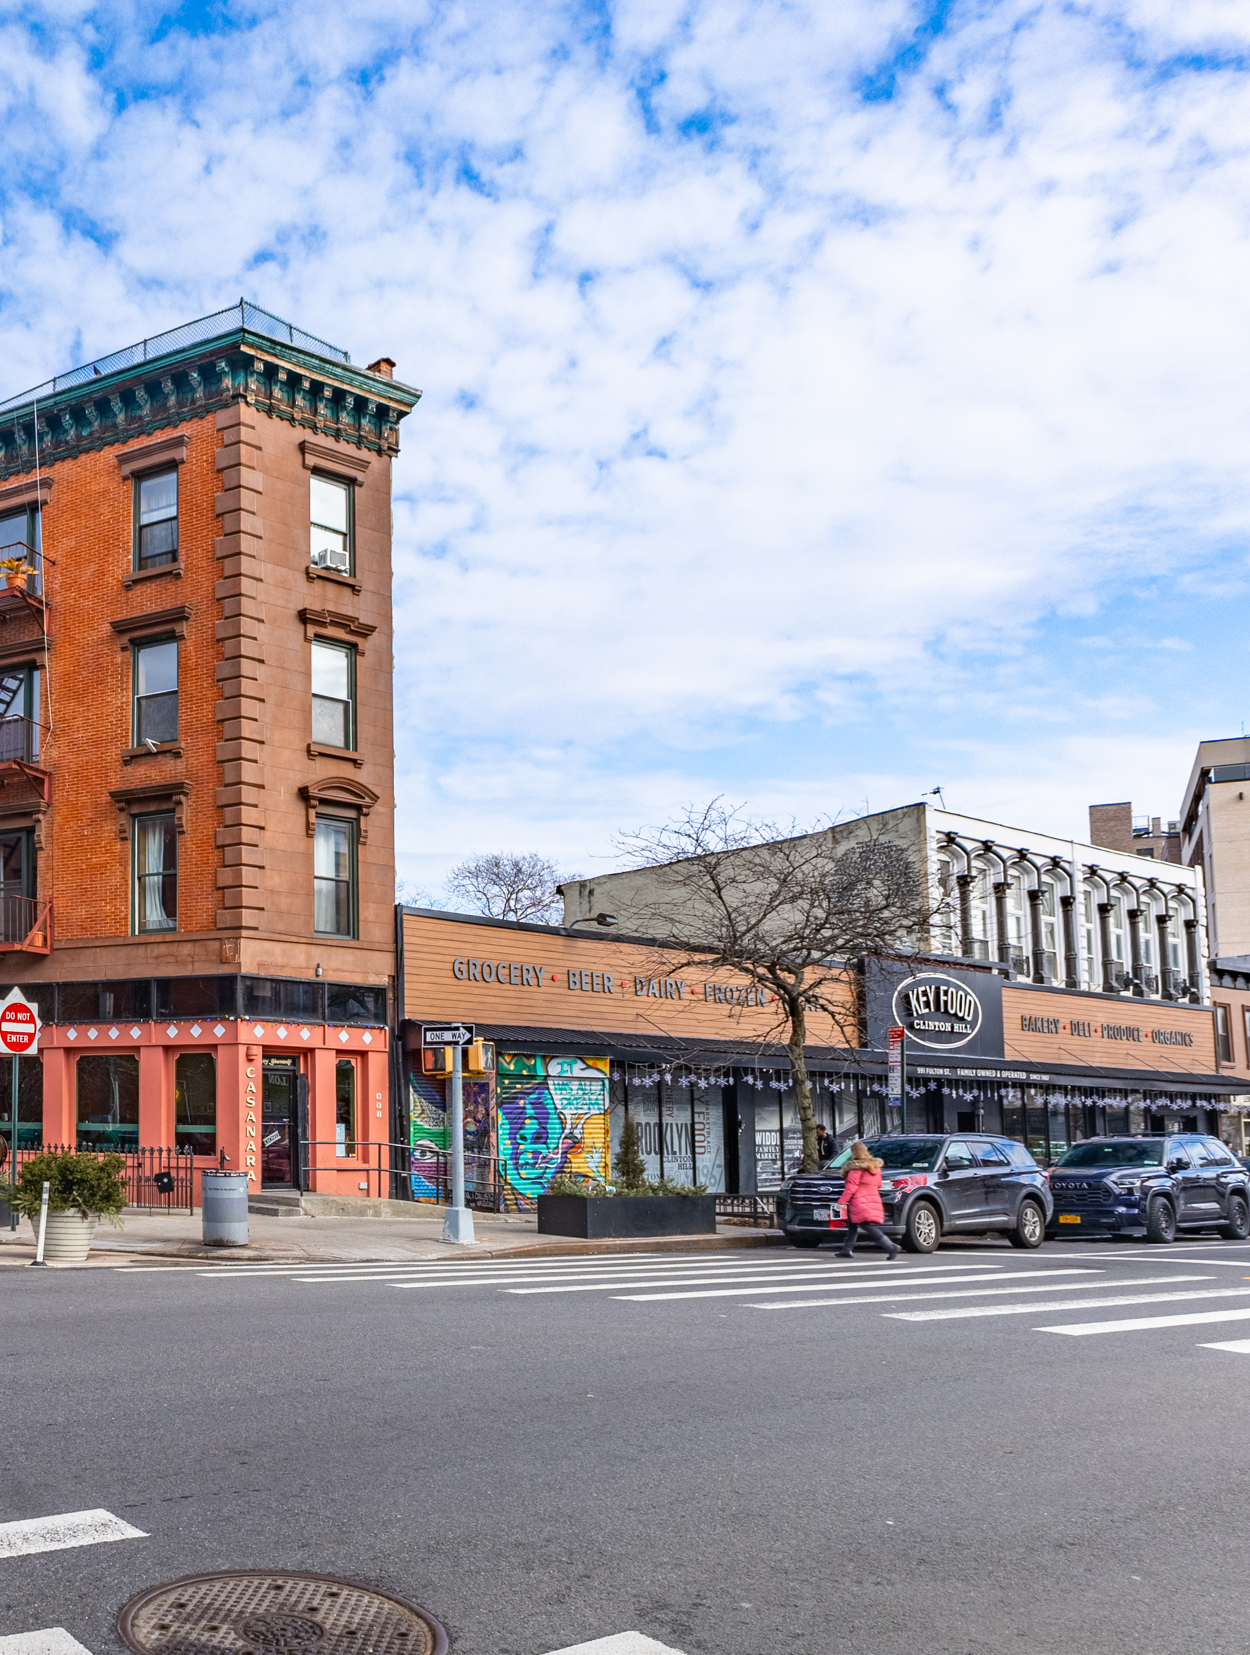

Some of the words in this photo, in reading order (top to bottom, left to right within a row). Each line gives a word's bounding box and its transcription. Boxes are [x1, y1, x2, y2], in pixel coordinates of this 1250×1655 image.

[453, 958, 545, 987] GROCERY
[567, 969, 614, 994] BEER
[634, 975, 686, 1000] DAIRY
[704, 982, 766, 1007] FROZEN
[908, 985, 935, 1017] KEY
[939, 985, 975, 1021] FOOD
[5, 1011, 16, 1020] DO
[17, 1012, 31, 1021] NOT
[913, 1020, 951, 1032] CLINTON
[953, 1023, 972, 1034] HILL
[6, 1034, 29, 1043] ENTER
[430, 1032, 445, 1041] ONE
[451, 1032, 467, 1040] WAY
[1021, 1014, 1060, 1034] BAKERY
[1070, 1020, 1092, 1038] DELI
[1101, 1023, 1143, 1043] PRODUCE
[1151, 1029, 1194, 1047] ORGANICS
[926, 1067, 943, 1075] FULTON
[957, 1068, 976, 1077] FAMILY
[977, 1069, 996, 1077] OWNED
[1001, 1070, 1026, 1079] OPERATED
[245, 1067, 257, 1182] CASANARA
[694, 1111, 707, 1155] FOOD
[636, 1122, 693, 1155] ROOKLYN
[755, 1132, 780, 1145] WIDDI
